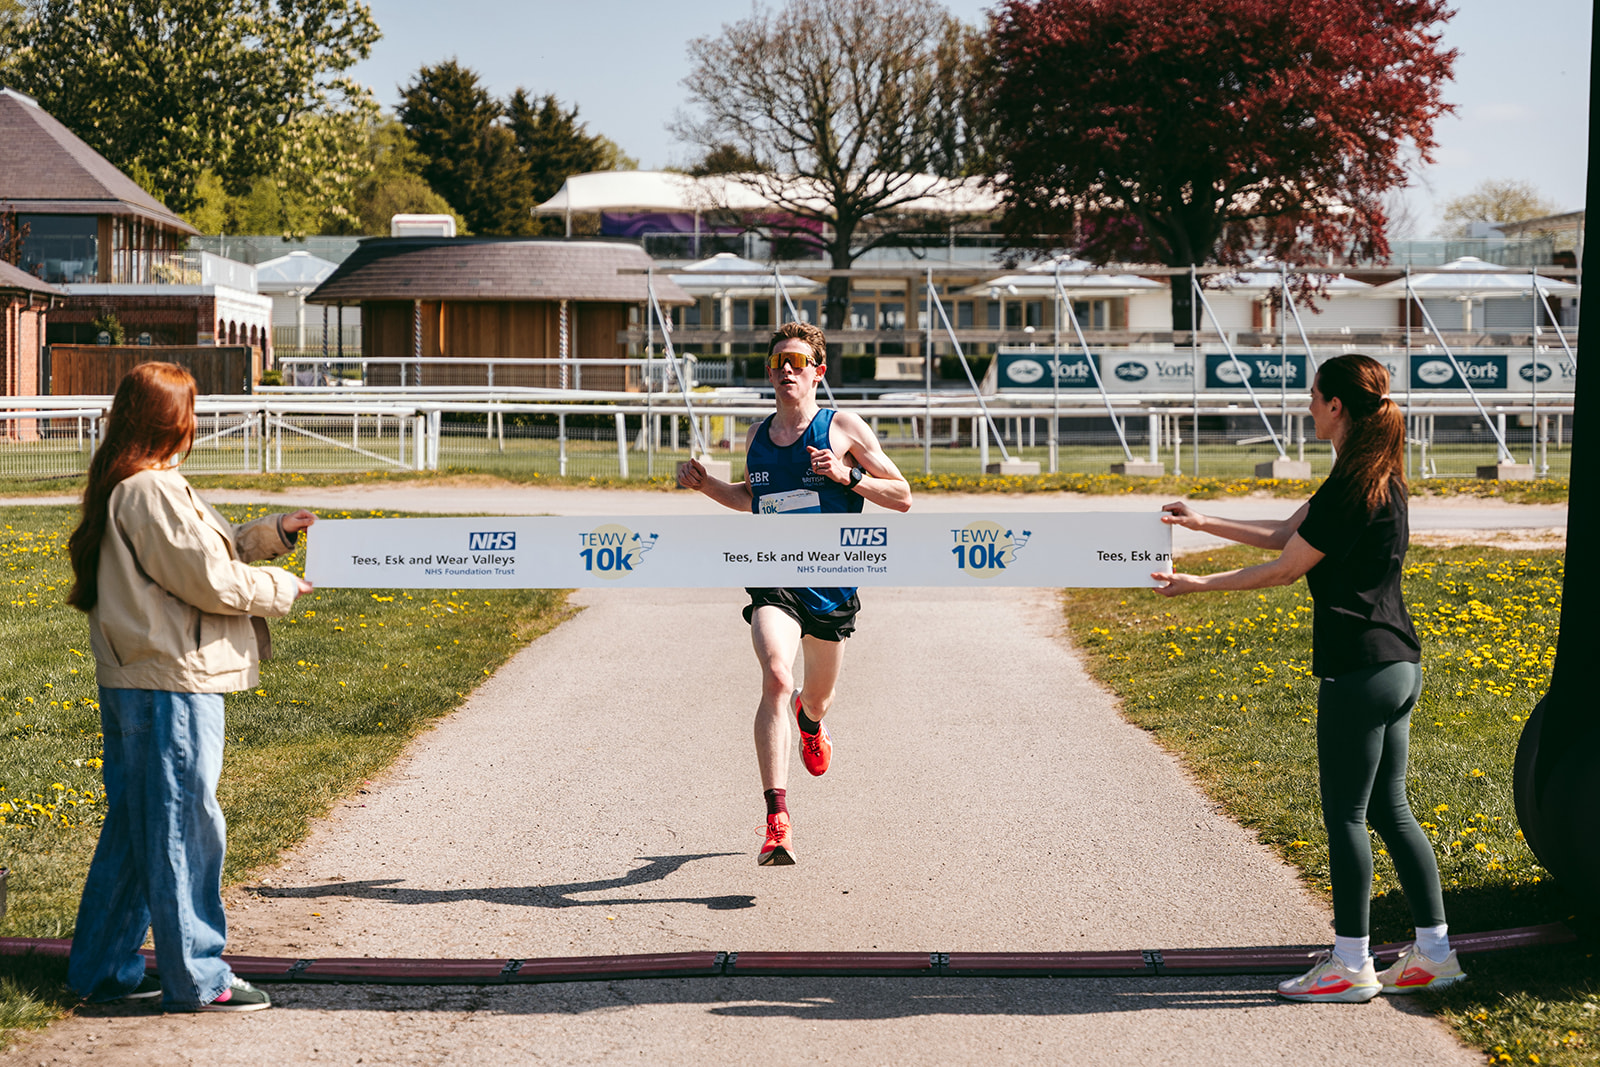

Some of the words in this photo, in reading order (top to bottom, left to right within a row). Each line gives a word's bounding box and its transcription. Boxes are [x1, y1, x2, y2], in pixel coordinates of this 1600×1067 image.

[1047, 360, 1089, 378] York
[1154, 360, 1194, 377] York
[1458, 360, 1498, 378] York
[749, 471, 770, 483] GBR
[762, 504, 778, 514] 10k
[470, 533, 514, 550] NHS
[578, 532, 627, 546] TEWV
[841, 528, 886, 546] NHS
[950, 529, 999, 543] TEWV
[352, 555, 381, 566] Tees,
[385, 555, 405, 565] Esk
[409, 554, 432, 565] and
[436, 555, 468, 565] Wear
[472, 554, 515, 566] Valleys
[579, 546, 633, 571] 10k
[723, 552, 753, 564] Tees,
[757, 551, 777, 562] Esk
[780, 551, 804, 562] and
[808, 551, 840, 562] Wear
[844, 550, 887, 564] Valleys
[951, 543, 1006, 569] 10k
[1097, 550, 1127, 562] Tees,
[1131, 550, 1152, 562] Esk
[1155, 552, 1173, 562] an
[817, 565, 864, 573] Foundation
[867, 565, 887, 573] Trust
